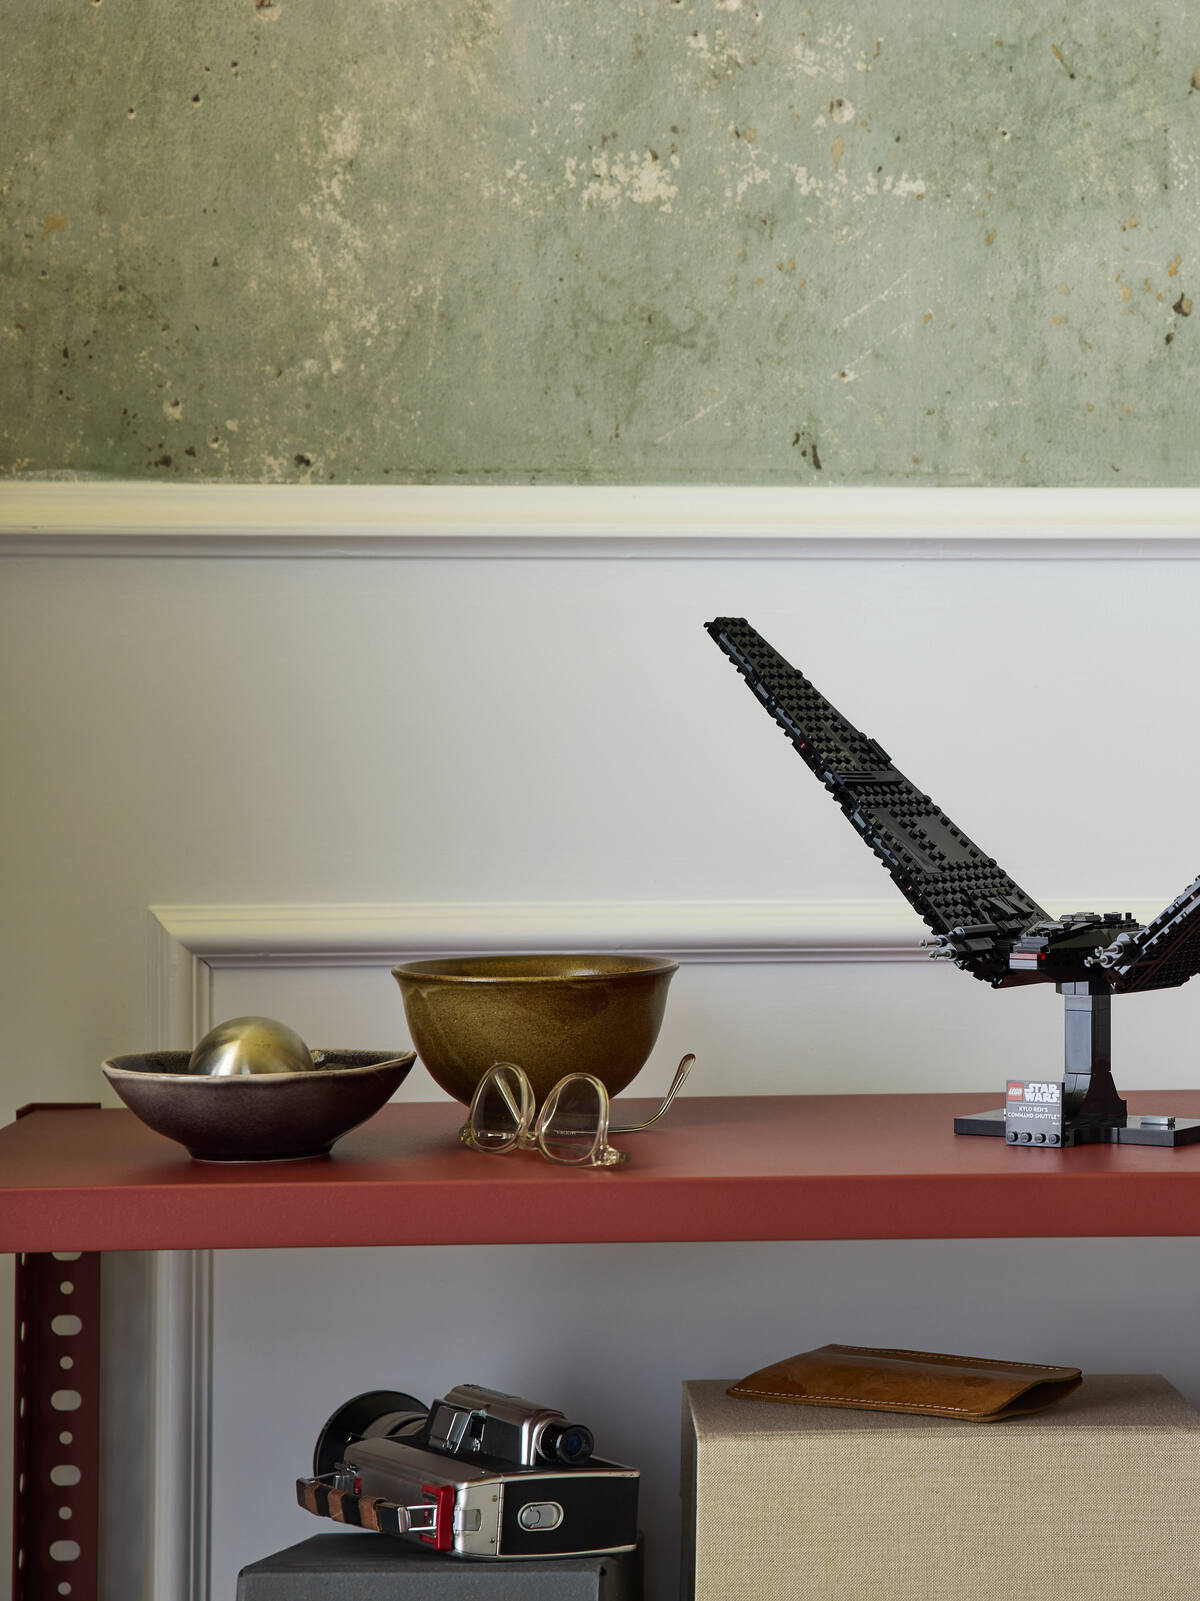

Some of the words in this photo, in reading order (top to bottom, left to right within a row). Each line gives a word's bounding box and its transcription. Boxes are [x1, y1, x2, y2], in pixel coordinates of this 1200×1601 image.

[1008, 1088, 1023, 1096] LEGO
[1024, 1084, 1060, 1093] STAR
[1024, 1093, 1060, 1103] WARS
